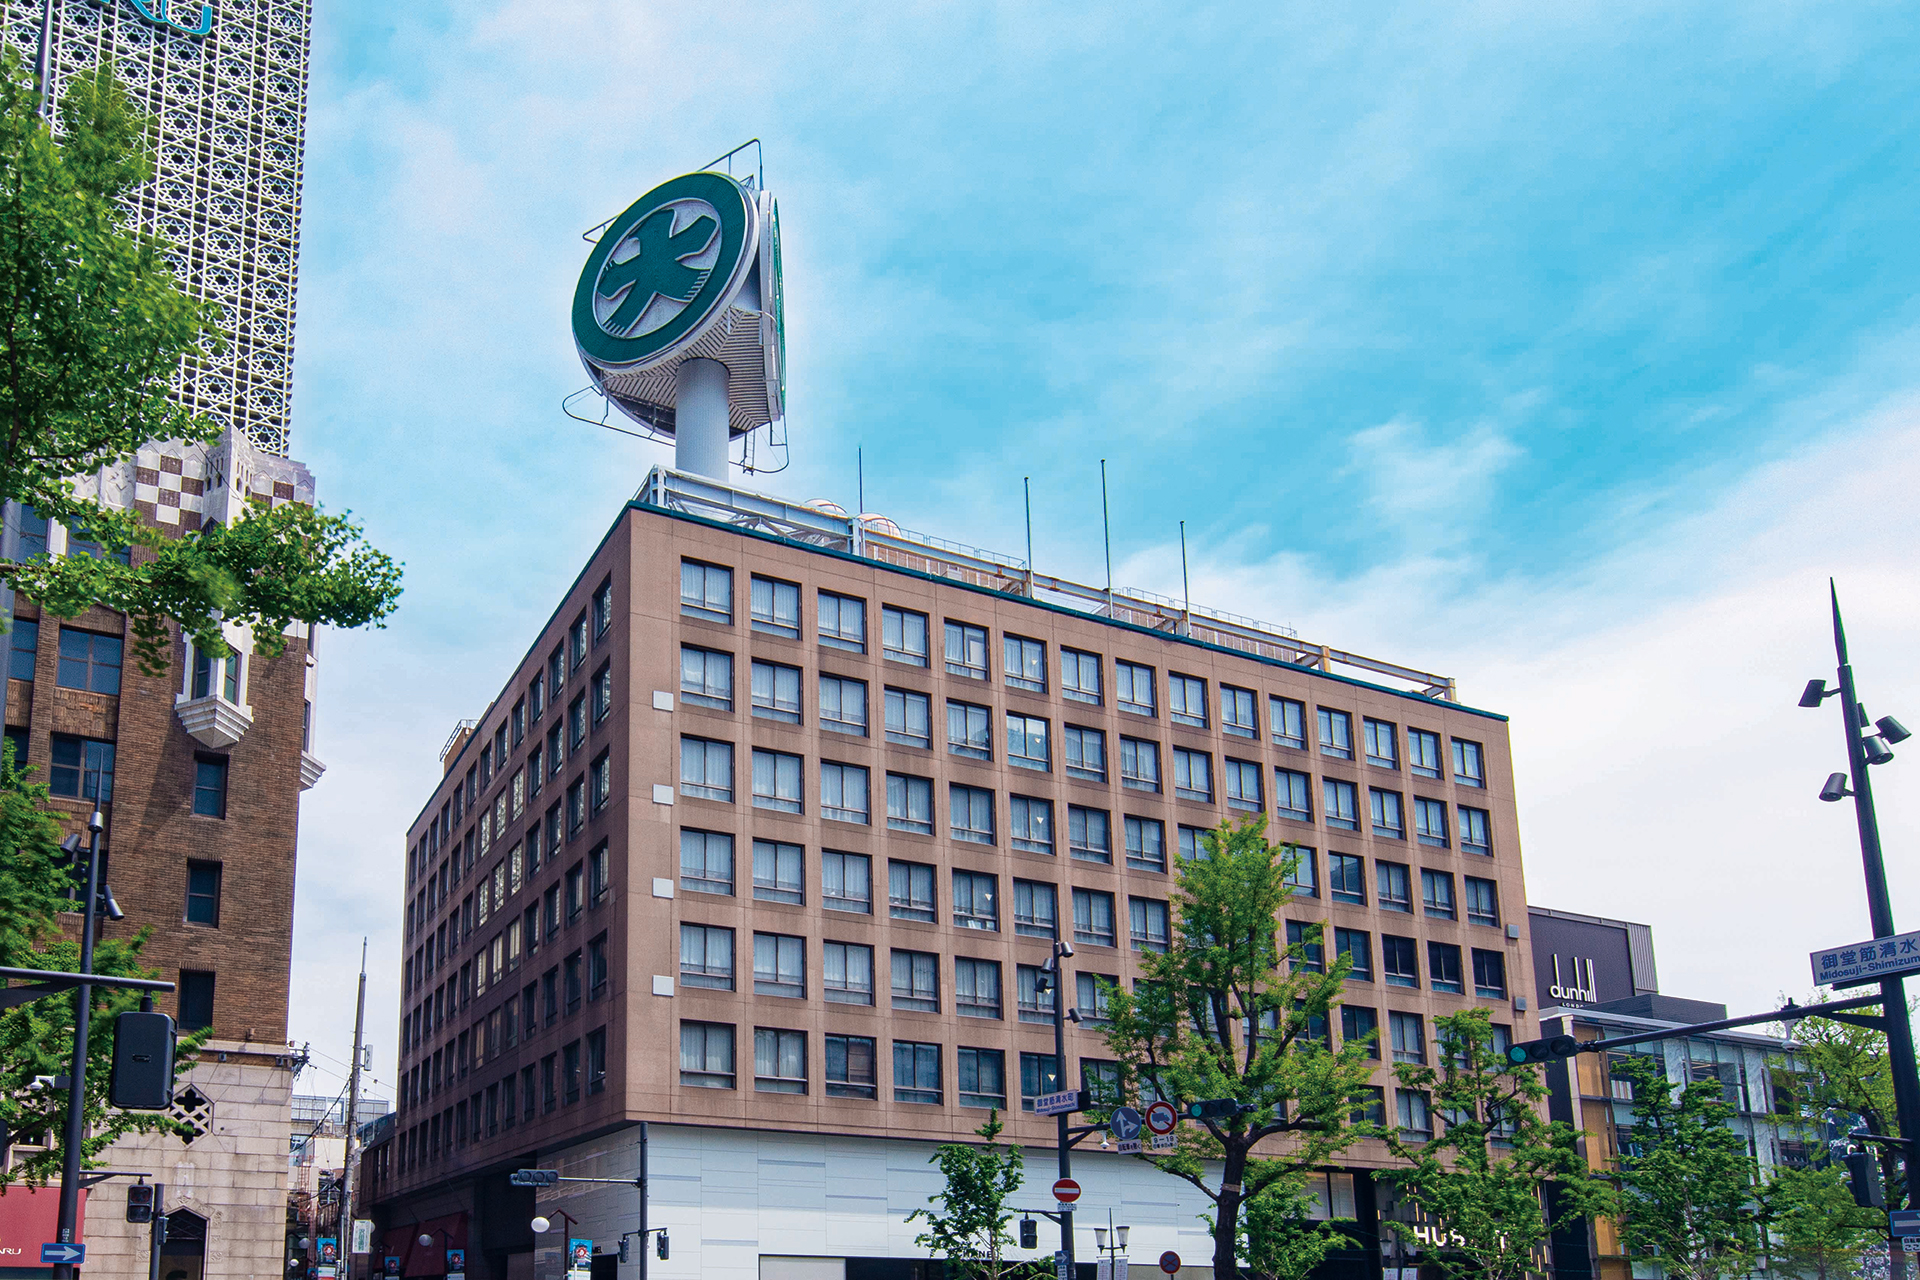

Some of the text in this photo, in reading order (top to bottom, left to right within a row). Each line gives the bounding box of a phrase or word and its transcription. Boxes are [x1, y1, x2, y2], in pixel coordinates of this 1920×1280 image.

[1820, 938, 1920, 970] 御堂筋清水
[1820, 955, 1920, 980] Midosuji-Shimizum
[1550, 953, 1597, 1003] dunhill
